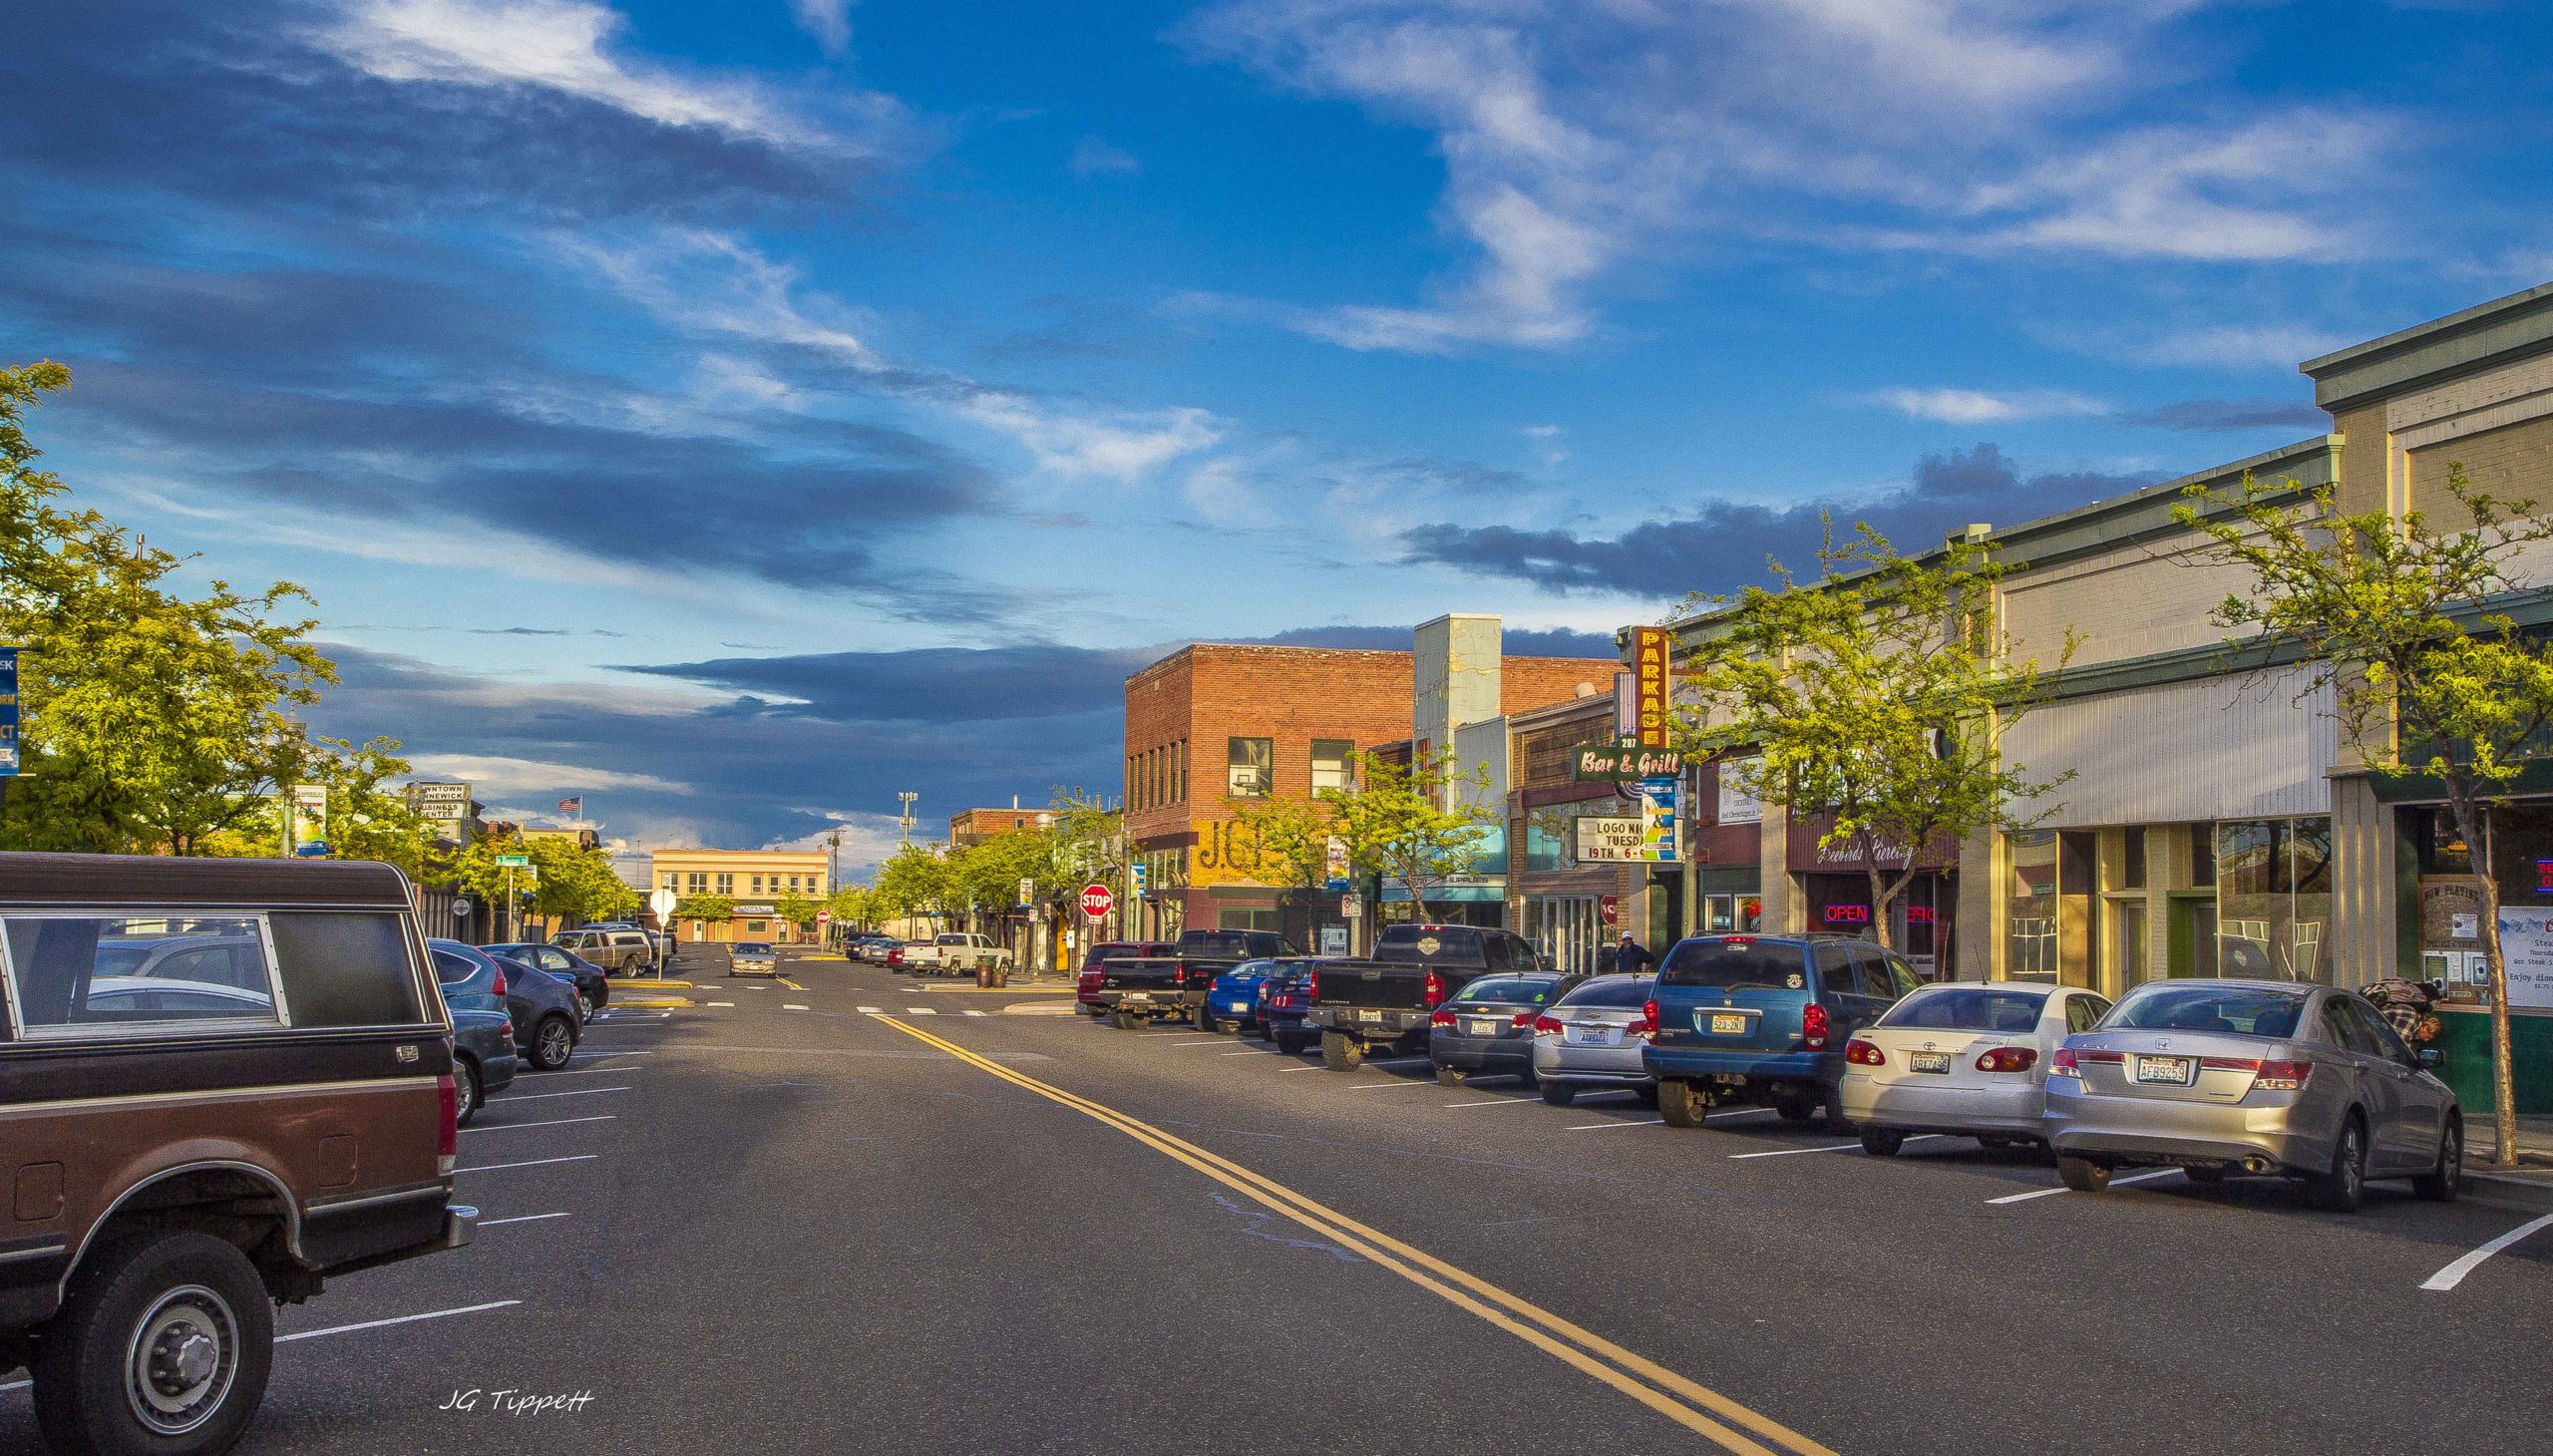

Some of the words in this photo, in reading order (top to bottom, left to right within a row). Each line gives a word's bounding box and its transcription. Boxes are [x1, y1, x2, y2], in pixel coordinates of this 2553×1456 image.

[1622, 738, 1637, 748] 207
[1581, 751, 1615, 773] Bar
[1620, 754, 1635, 773] &
[1639, 753, 1679, 777] Grill
[1597, 823, 1626, 834] LOGO
[1606, 835, 1643, 846] TUESDA
[1589, 848, 1614, 859] 19TH
[1082, 895, 1111, 908] STOP
[1826, 906, 1868, 920] OPEN
[2509, 973, 2532, 982] Enjoy
[2140, 1065, 2185, 1080] AFB9259
